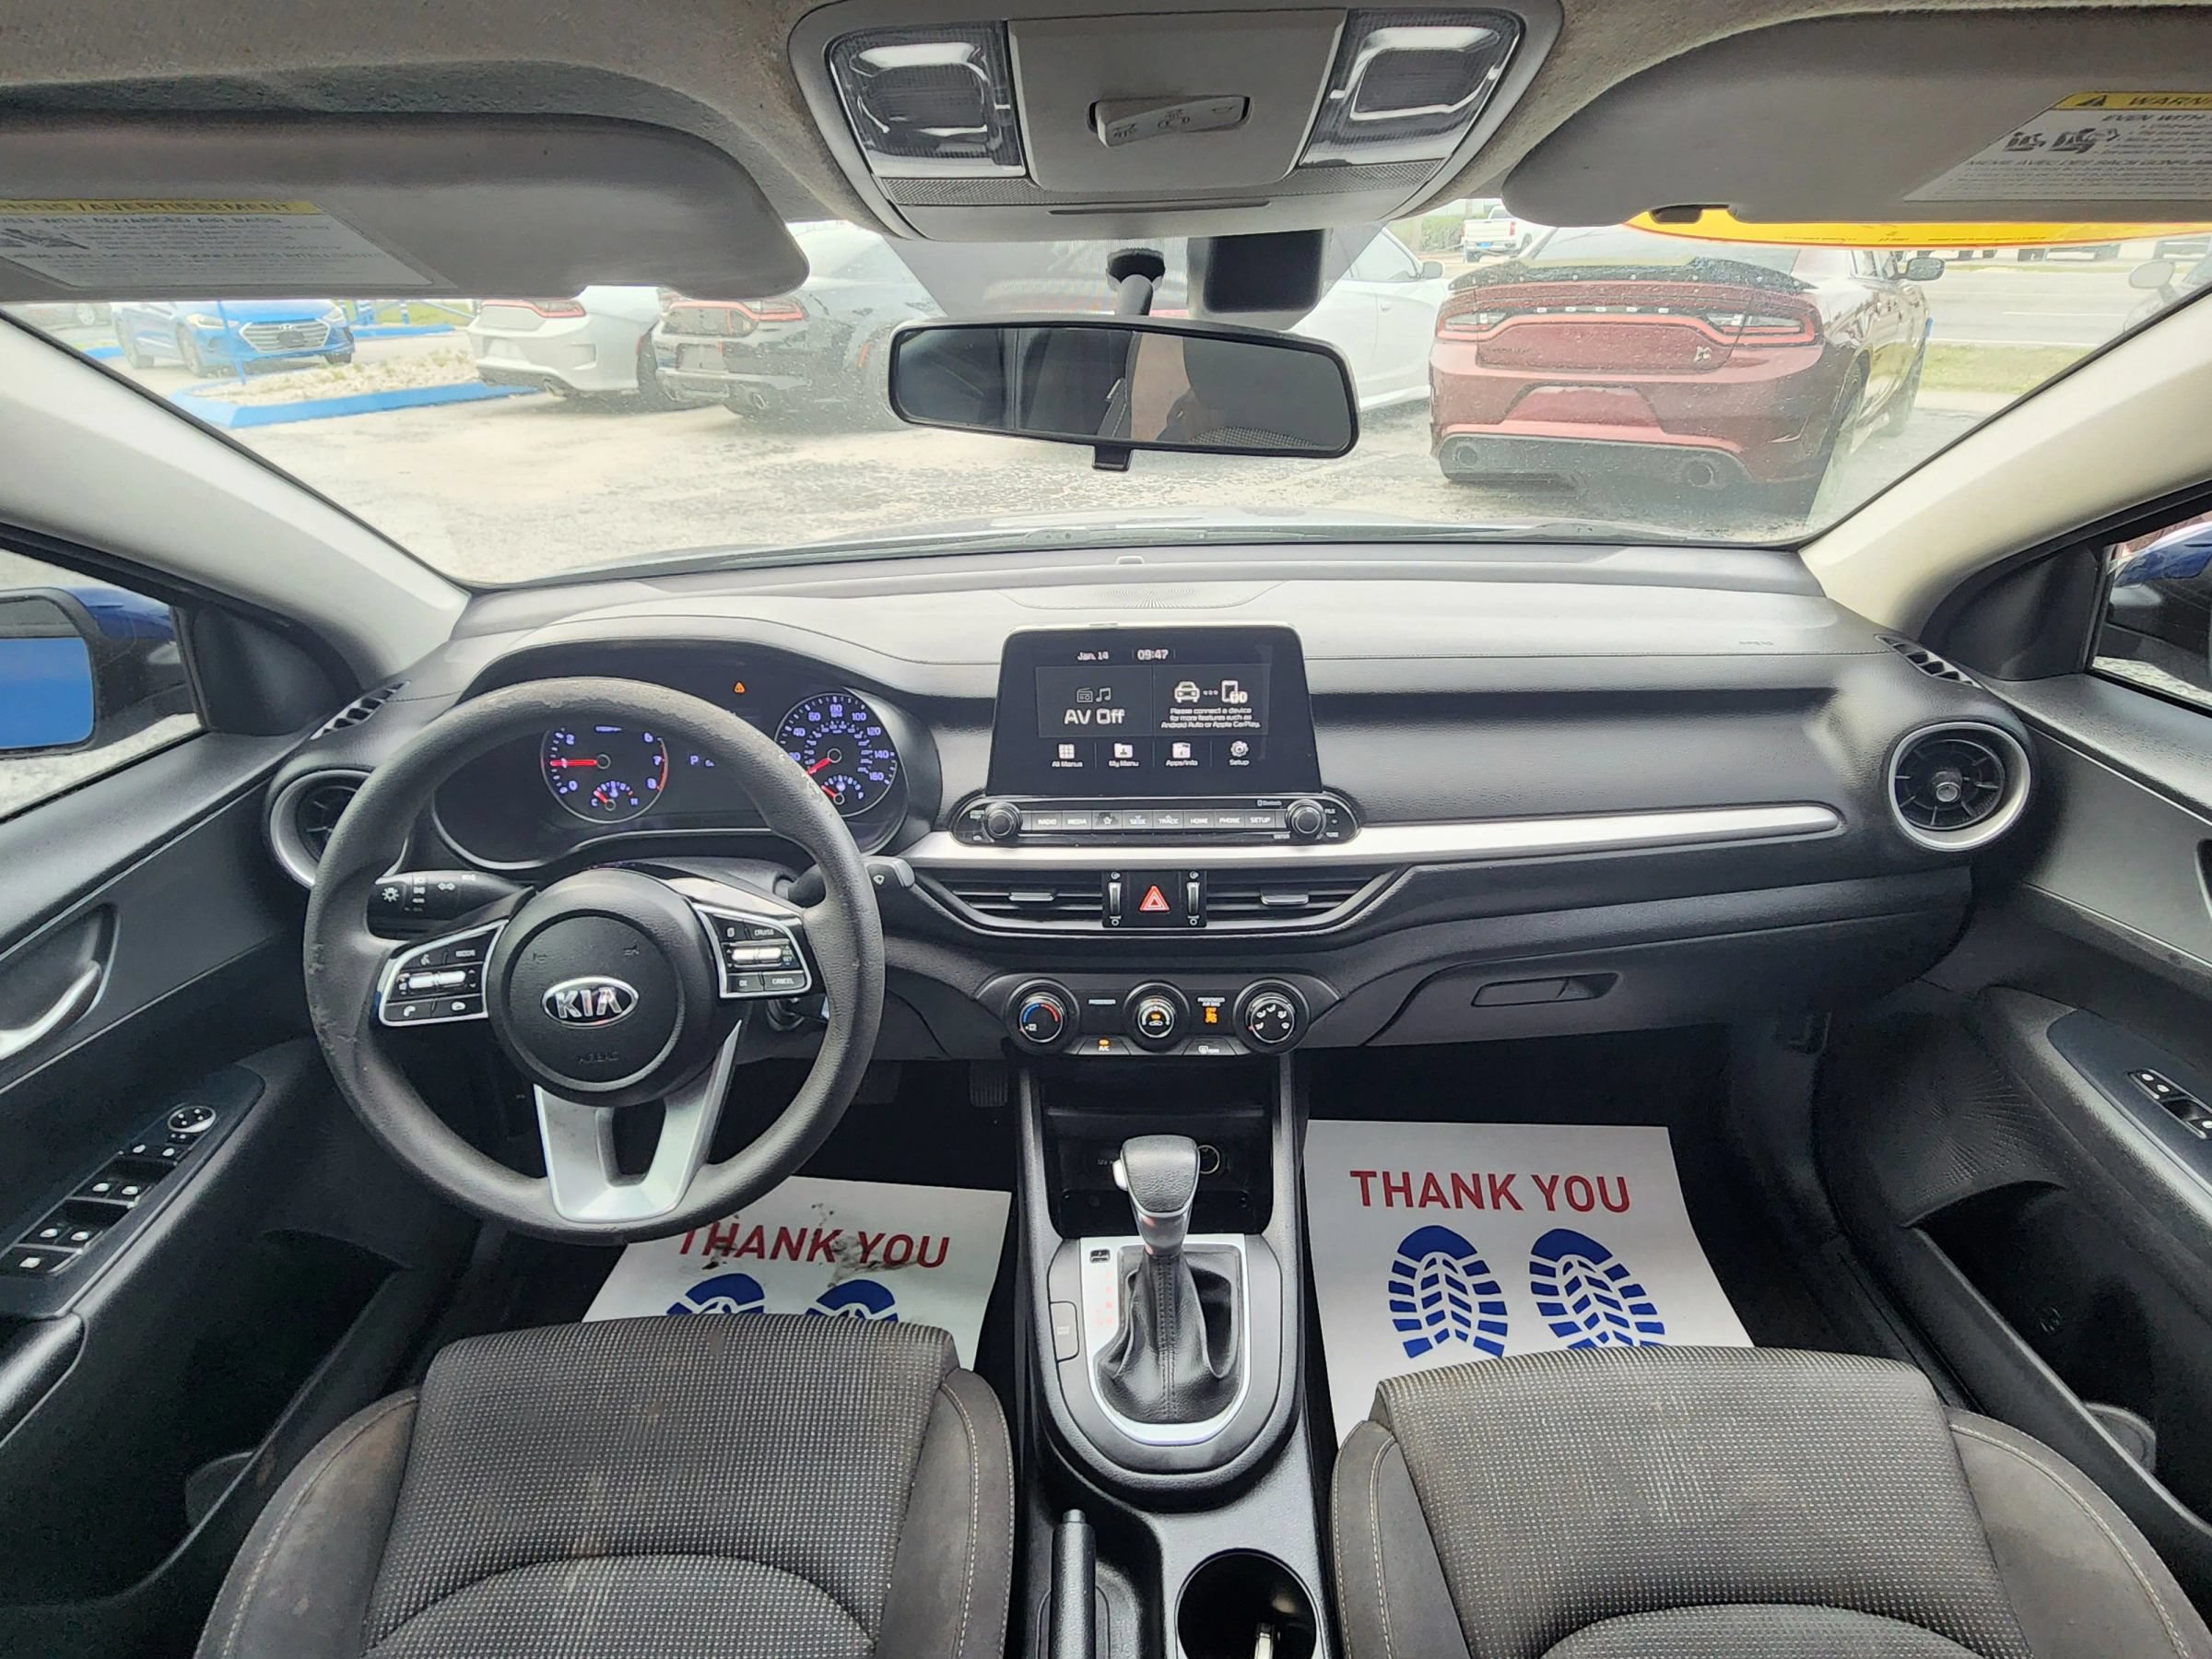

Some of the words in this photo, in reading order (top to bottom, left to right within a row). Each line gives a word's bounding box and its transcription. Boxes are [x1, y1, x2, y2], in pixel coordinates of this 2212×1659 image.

[1137, 649, 1169, 661] 09:47
[852, 712, 867, 722] 100
[1064, 708, 1091, 725] AV
[1096, 707, 1125, 724] Off
[1161, 721, 1187, 729] Android
[1213, 721, 1232, 729] Apple
[793, 727, 806, 737] 40
[874, 750, 889, 759] 140
[689, 754, 700, 766] P
[1190, 817, 1209, 825] HOME
[1250, 816, 1271, 824] SETUP
[771, 977, 794, 985] CANCEL
[555, 987, 622, 1019] KIA
[1349, 1171, 1524, 1212] THANK
[1531, 1174, 1630, 1214] YOU
[678, 1220, 844, 1264] THANK
[855, 1230, 950, 1269] YOU
